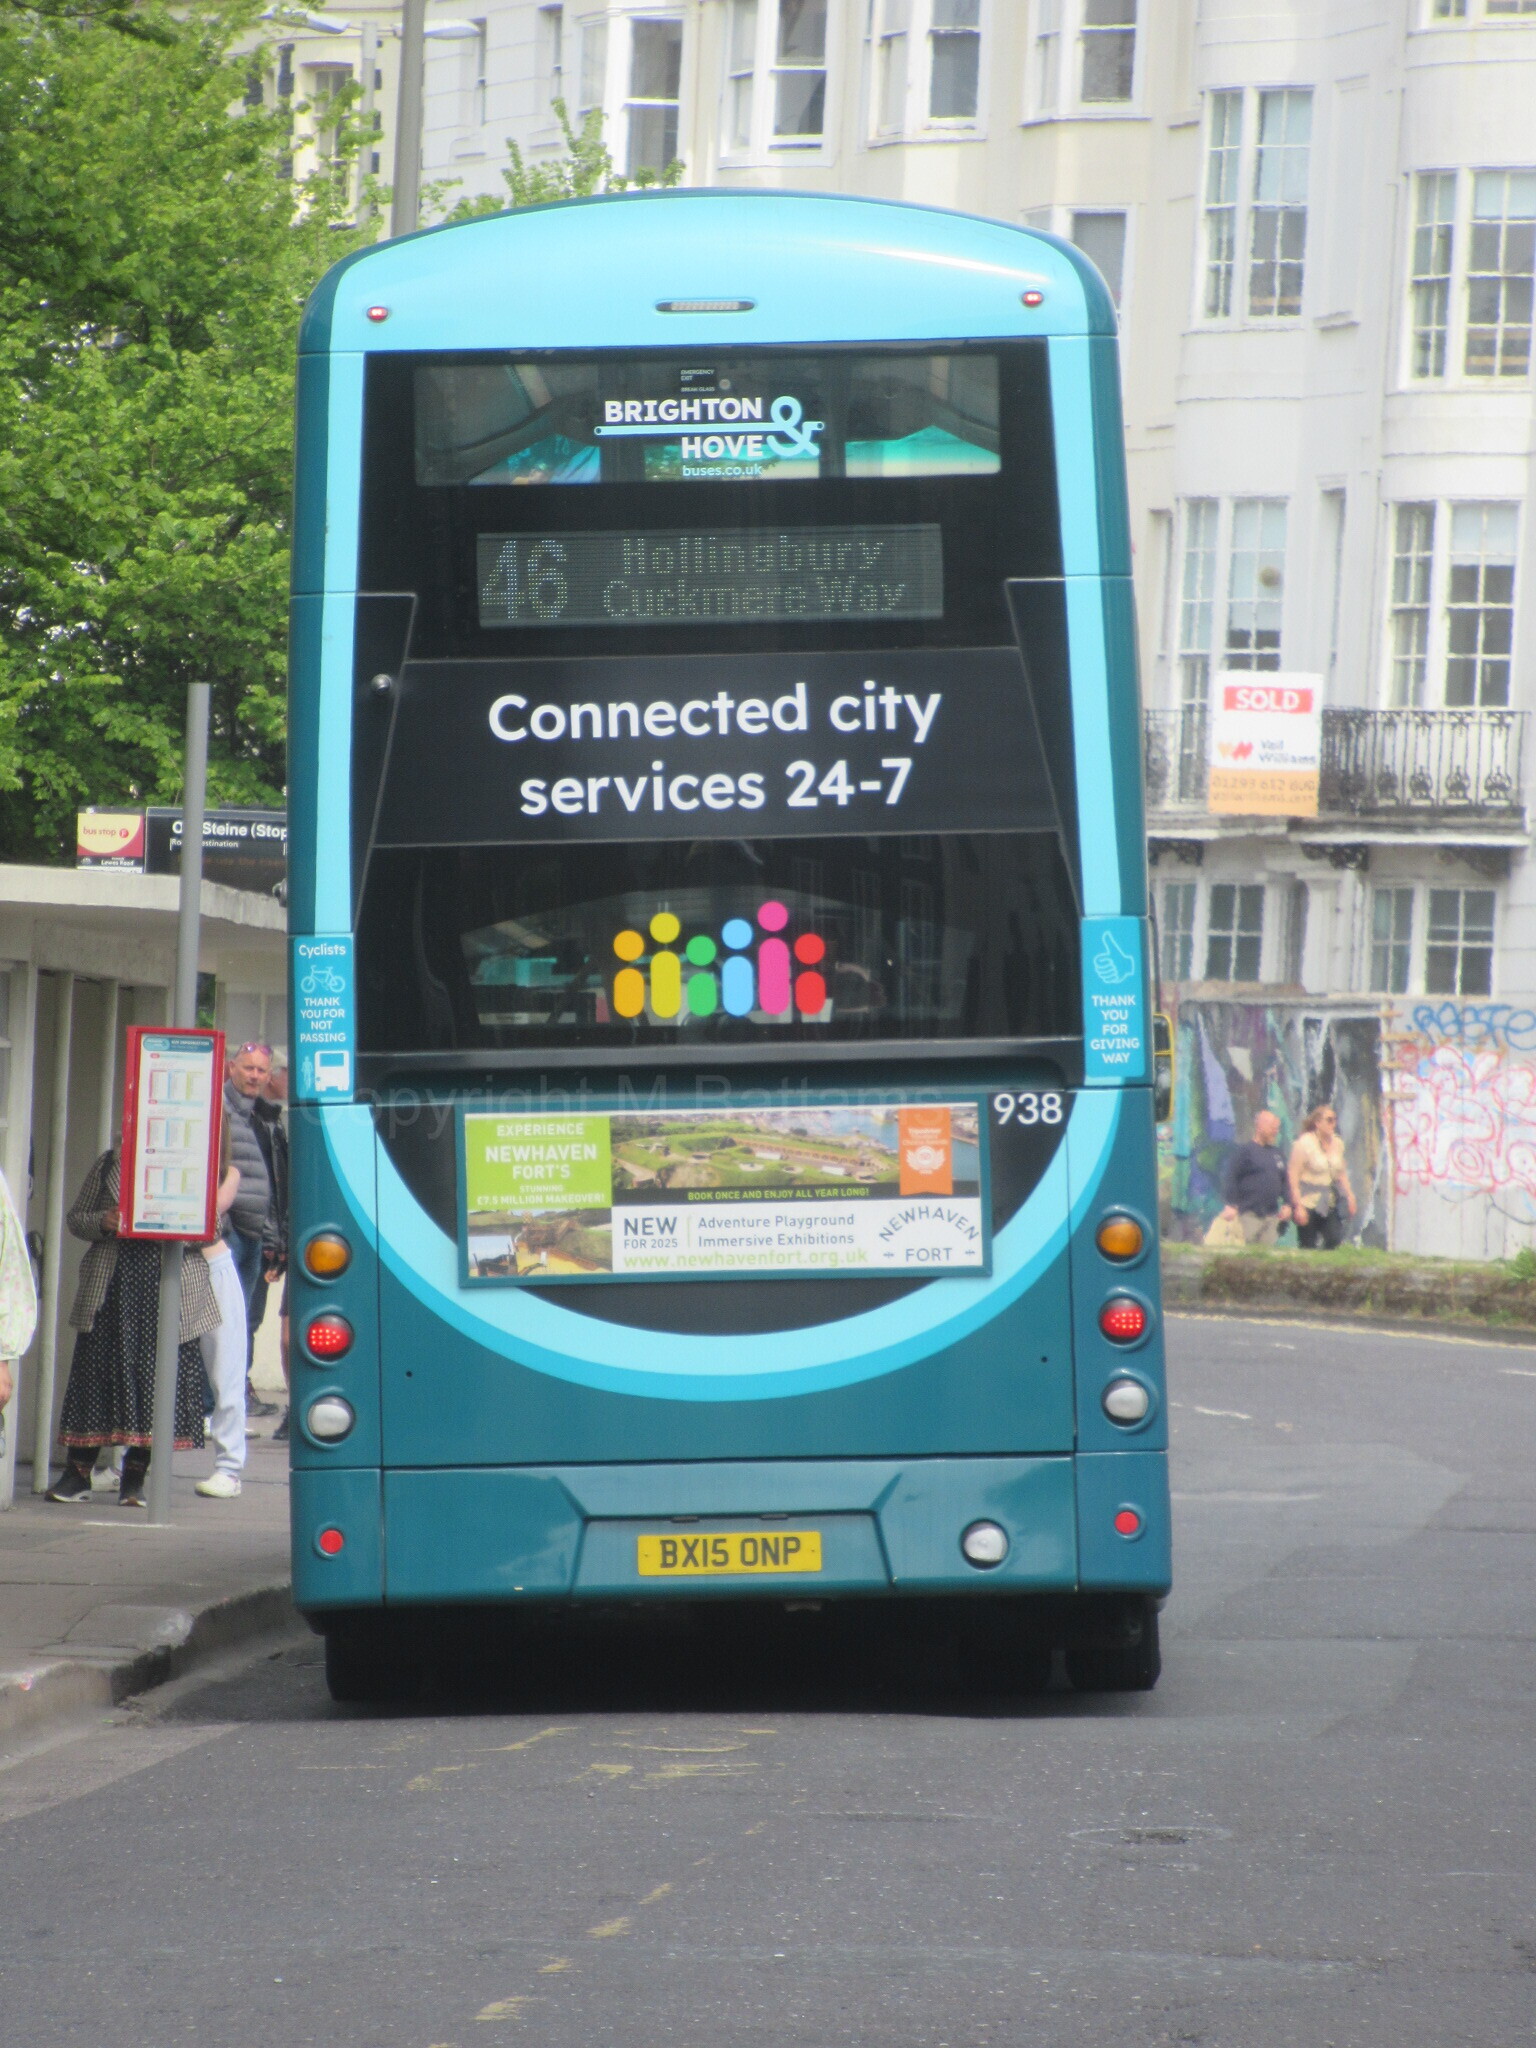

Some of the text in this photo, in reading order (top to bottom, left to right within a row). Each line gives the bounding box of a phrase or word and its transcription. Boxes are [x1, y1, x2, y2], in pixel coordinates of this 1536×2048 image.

[604, 397, 763, 423] BRIGHTON
[681, 434, 763, 459] HOVE
[682, 463, 763, 477] buses.co.uk
[623, 535, 884, 574] Hollingbury
[482, 539, 568, 619] 46
[603, 575, 906, 617] Cuckmere Way
[1235, 688, 1300, 710] SOLD
[488, 680, 941, 743] Connected city
[520, 757, 913, 815] services 24-7
[83, 826, 97, 835] bus
[99, 828, 117, 837] stop
[202, 821, 248, 836] Steine
[201, 840, 239, 848] estination
[299, 943, 347, 958] Cyclists
[303, 997, 340, 1006] THANK
[1091, 995, 1136, 1007] THANK
[300, 1008, 345, 1018] YOU FOR
[1101, 1009, 1128, 1021] YOU
[311, 1020, 333, 1030] NOT
[1102, 1024, 1128, 1035] FOR
[300, 1032, 346, 1043] PASSING
[1090, 1037, 1140, 1050] GIVING
[1101, 1052, 1130, 1064] WAY
[993, 1093, 1063, 1125] 938
[496, 1123, 585, 1137] EXPERIENCE
[485, 1143, 597, 1163] NEWHAVEN
[512, 1164, 571, 1180] FORT'S
[688, 1187, 870, 1200] BOOK ONCE AND ENJOY ALL YEAR LONG!
[624, 1216, 677, 1236] NEW
[698, 1214, 855, 1230] Adventure Playground
[879, 1206, 980, 1242] NEWHAVEN
[624, 1238, 678, 1249] FOR 2025
[698, 1233, 855, 1248] Immersive Exhibitions
[624, 1247, 868, 1268] www.newhavenfort.org.uk
[905, 1247, 953, 1262] FORT
[660, 1537, 801, 1568] BX15 ONP
